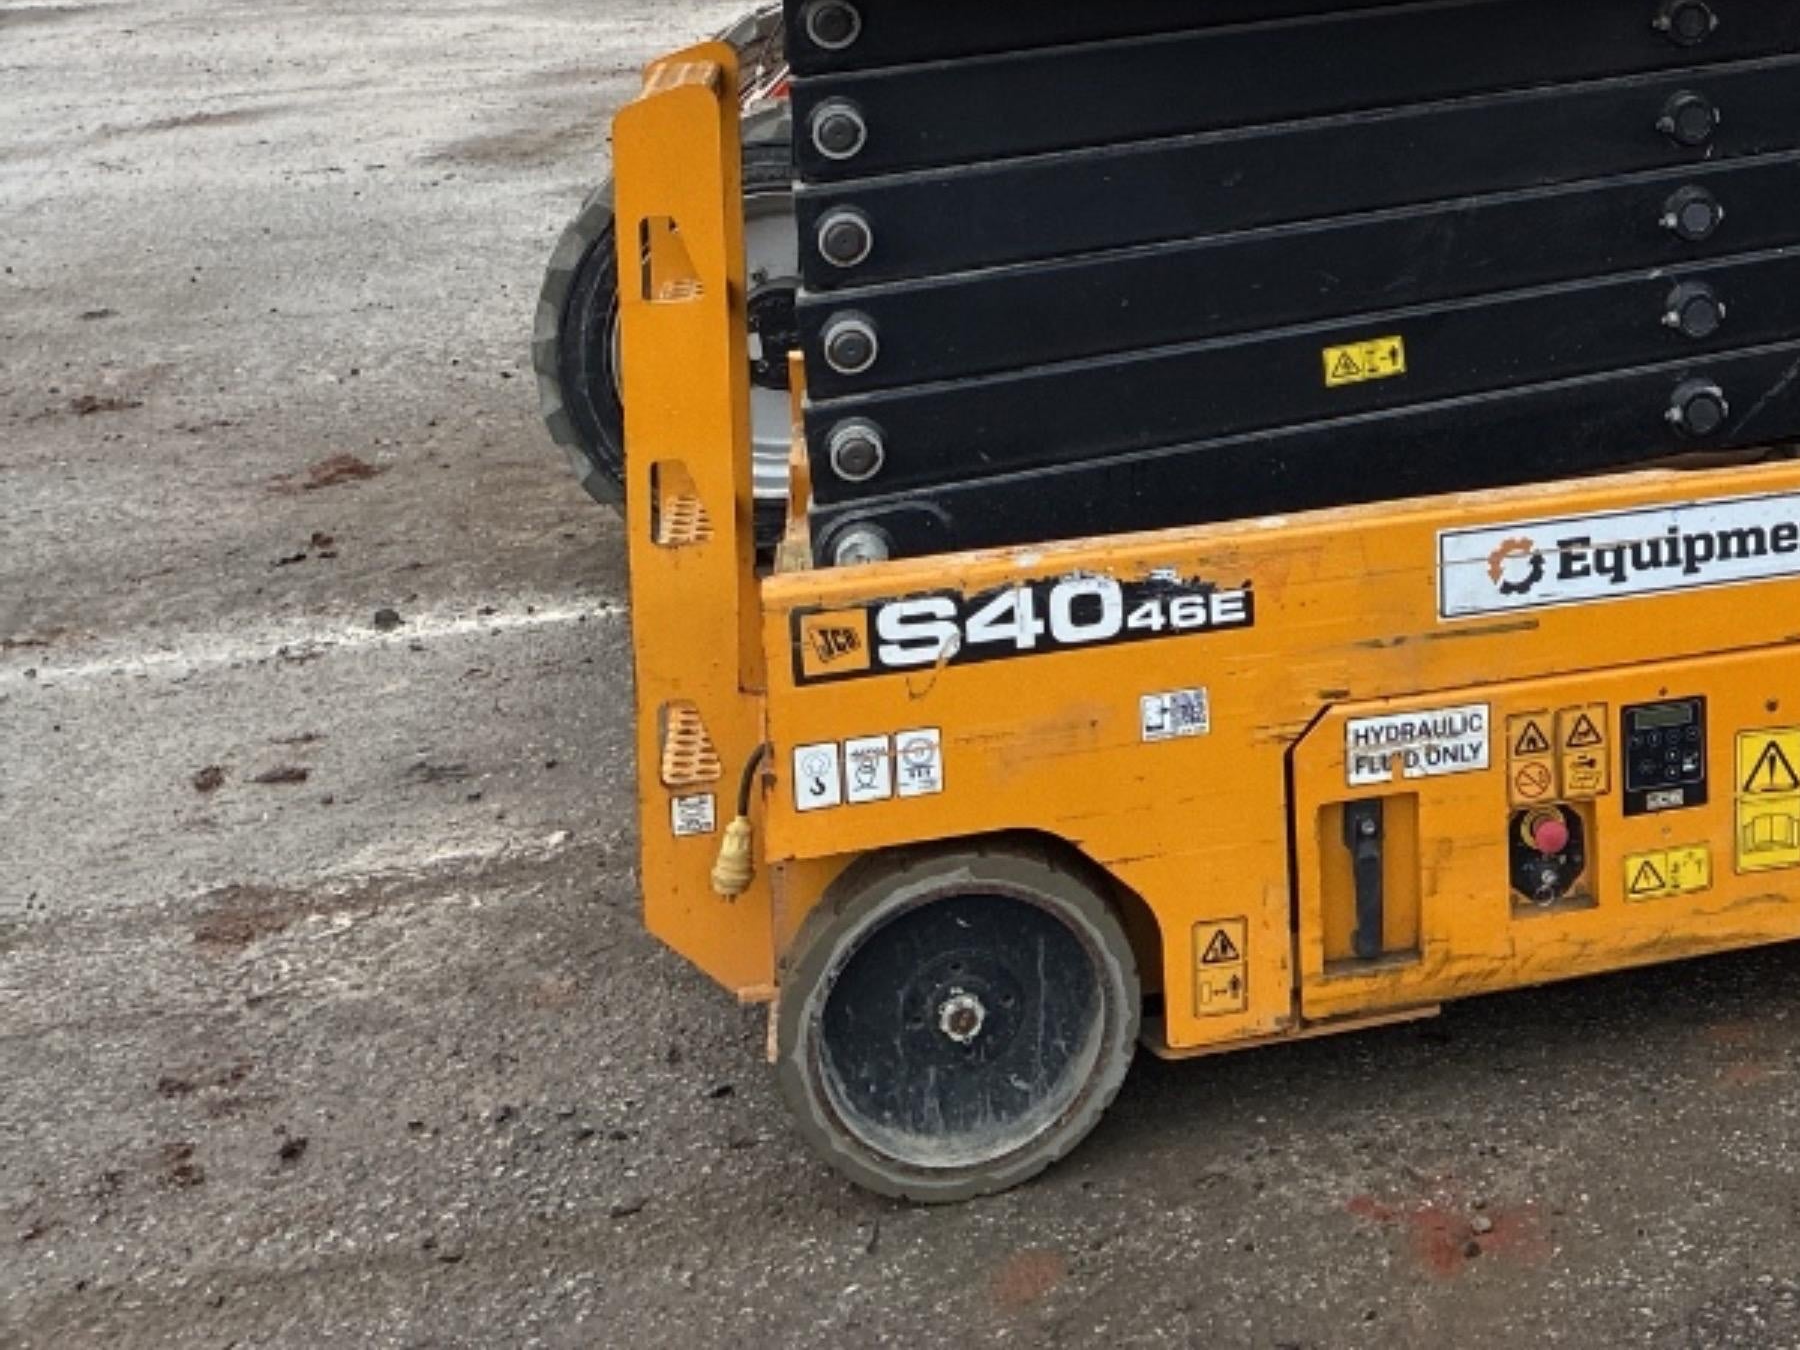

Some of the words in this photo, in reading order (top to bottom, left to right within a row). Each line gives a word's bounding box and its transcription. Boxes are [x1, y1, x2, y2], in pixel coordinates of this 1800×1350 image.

[876, 580, 1123, 666] S40
[1126, 590, 1247, 632] 46E
[1355, 713, 1483, 746] HYDRAULIC
[1355, 749, 1420, 775] FLUD
[1425, 740, 1483, 767] ONLY
